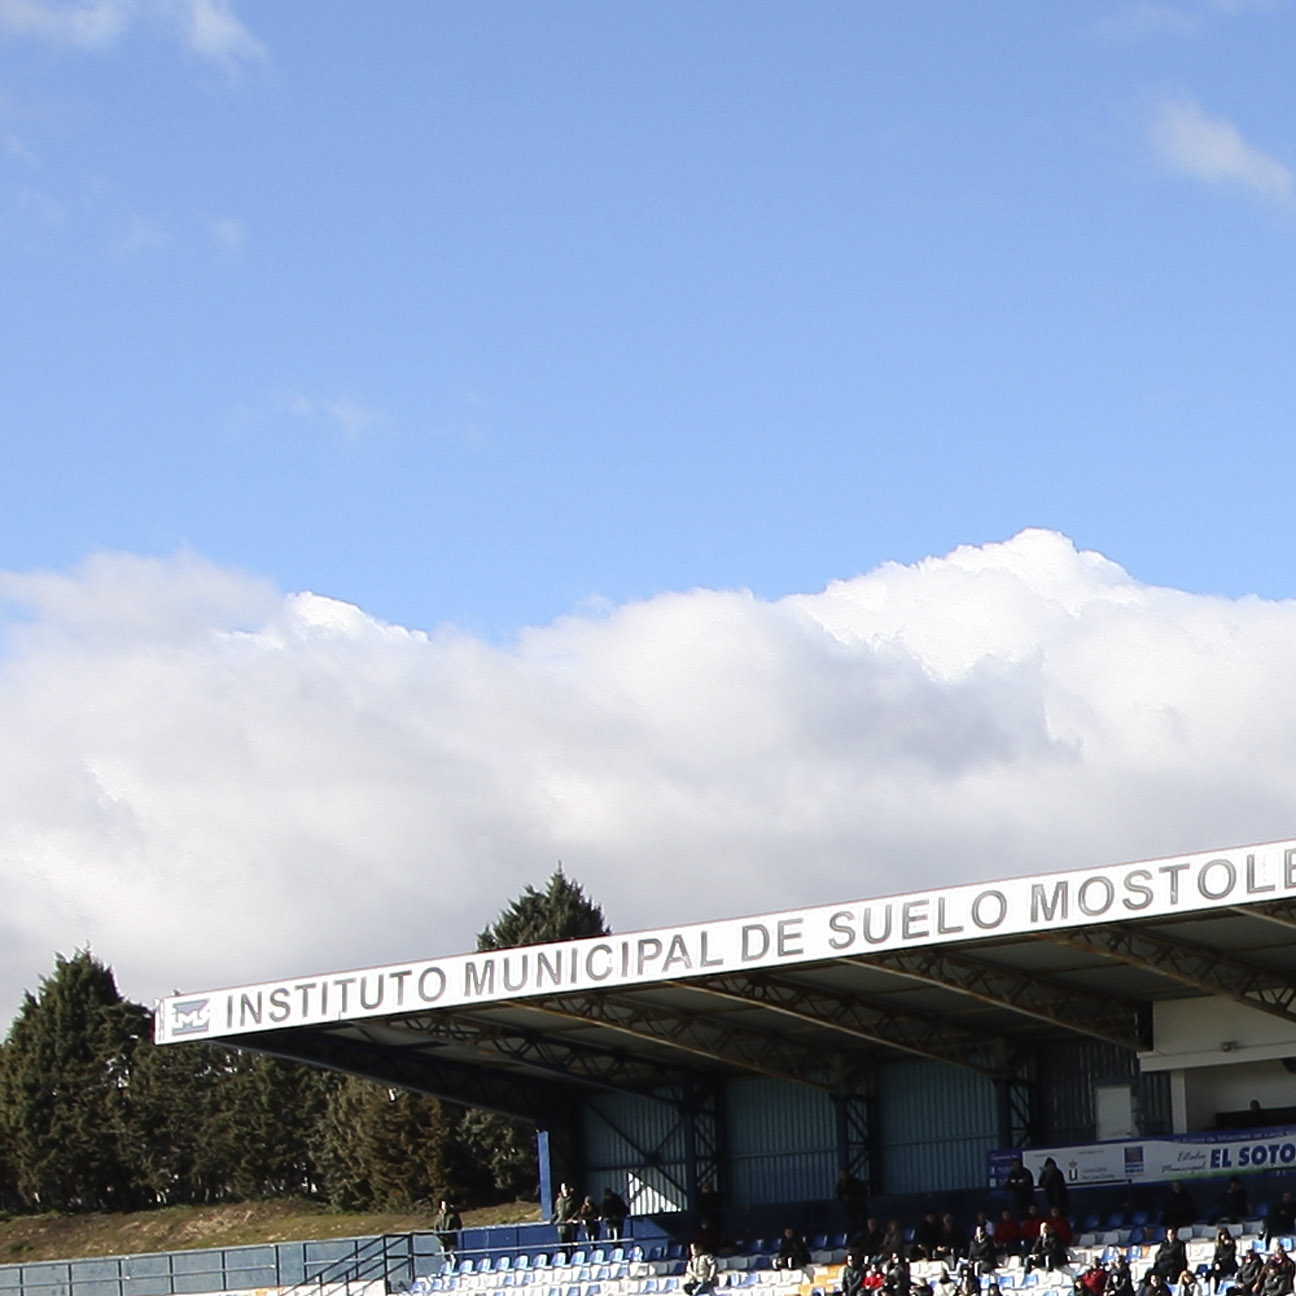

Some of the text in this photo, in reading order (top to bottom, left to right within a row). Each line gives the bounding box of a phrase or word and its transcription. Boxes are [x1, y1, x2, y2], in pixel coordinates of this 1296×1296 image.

[226, 966, 447, 1029] INSTITUTO
[465, 933, 724, 996] MUNICIPAL
[741, 920, 803, 962] DE
[828, 889, 1008, 951] SUELO
[1210, 1148, 1232, 1169] EL
[1238, 1144, 1296, 1167] SOTO
